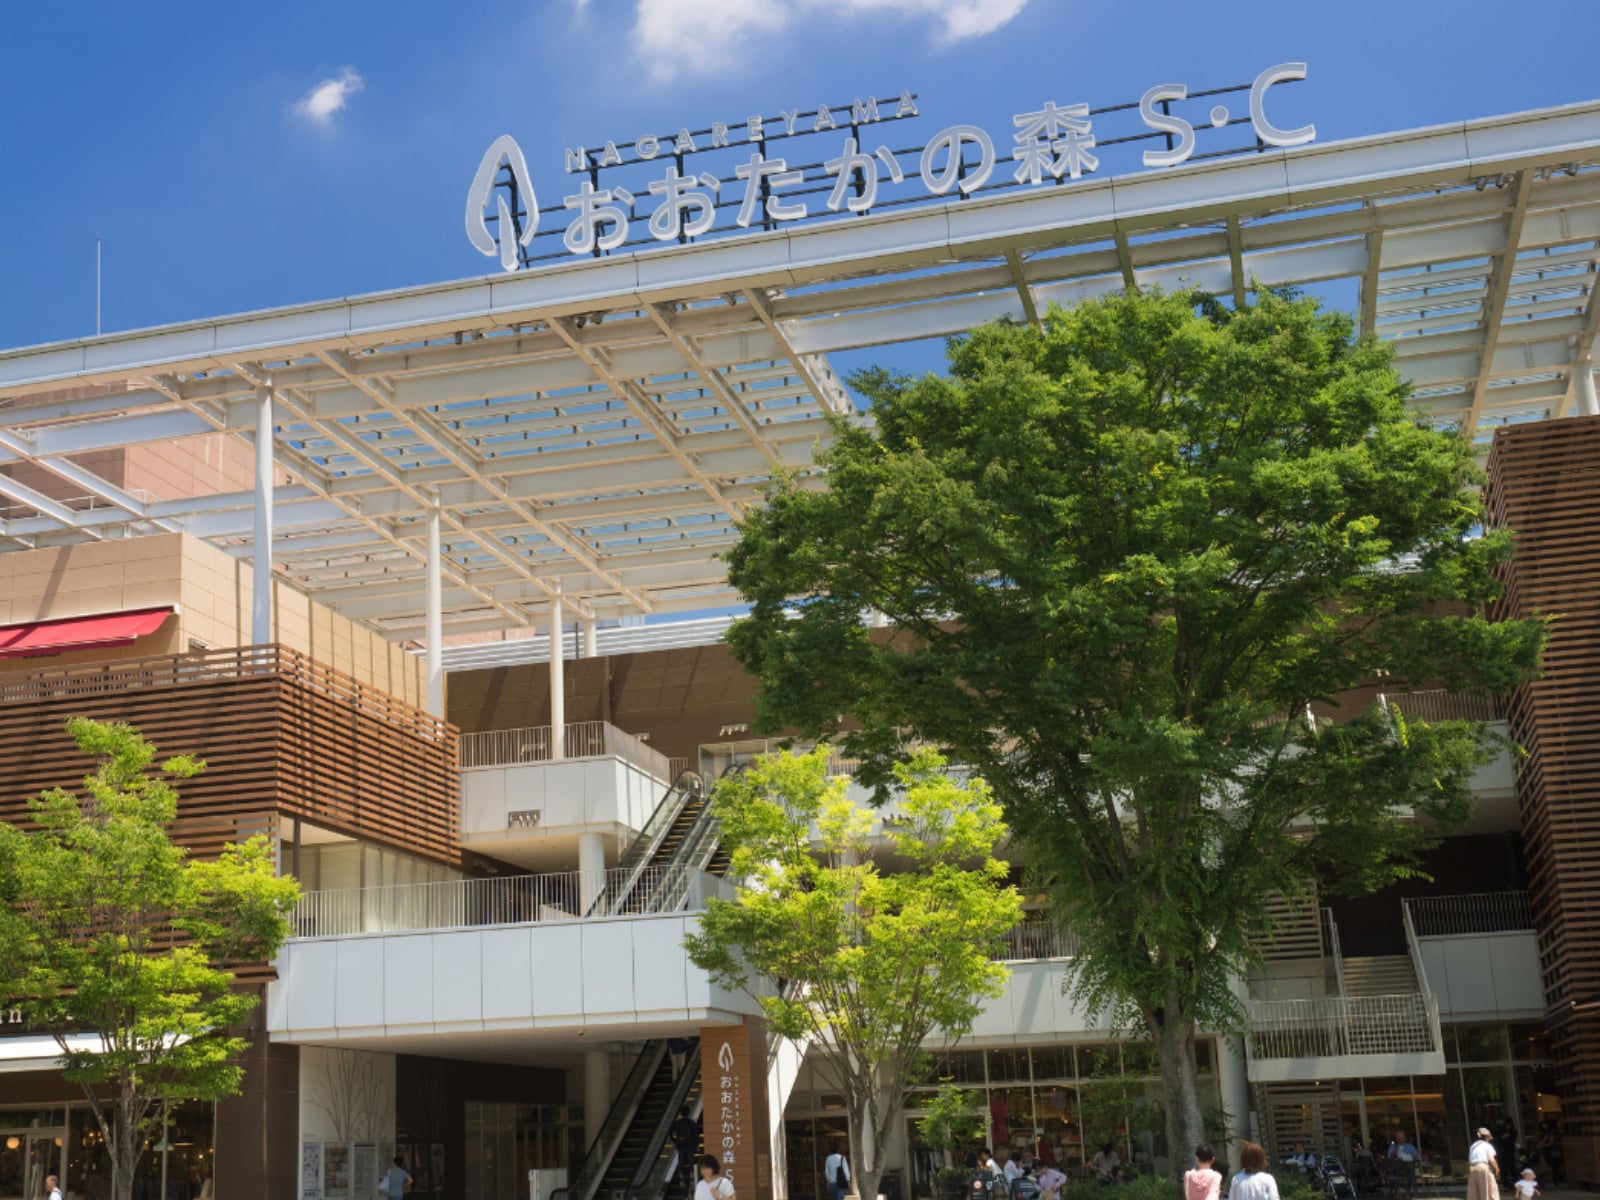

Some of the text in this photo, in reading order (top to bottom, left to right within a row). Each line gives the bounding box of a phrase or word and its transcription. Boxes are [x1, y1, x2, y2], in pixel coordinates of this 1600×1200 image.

[563, 101, 1099, 254] おおたかの森
[565, 91, 919, 173] NAGAREYAMA
